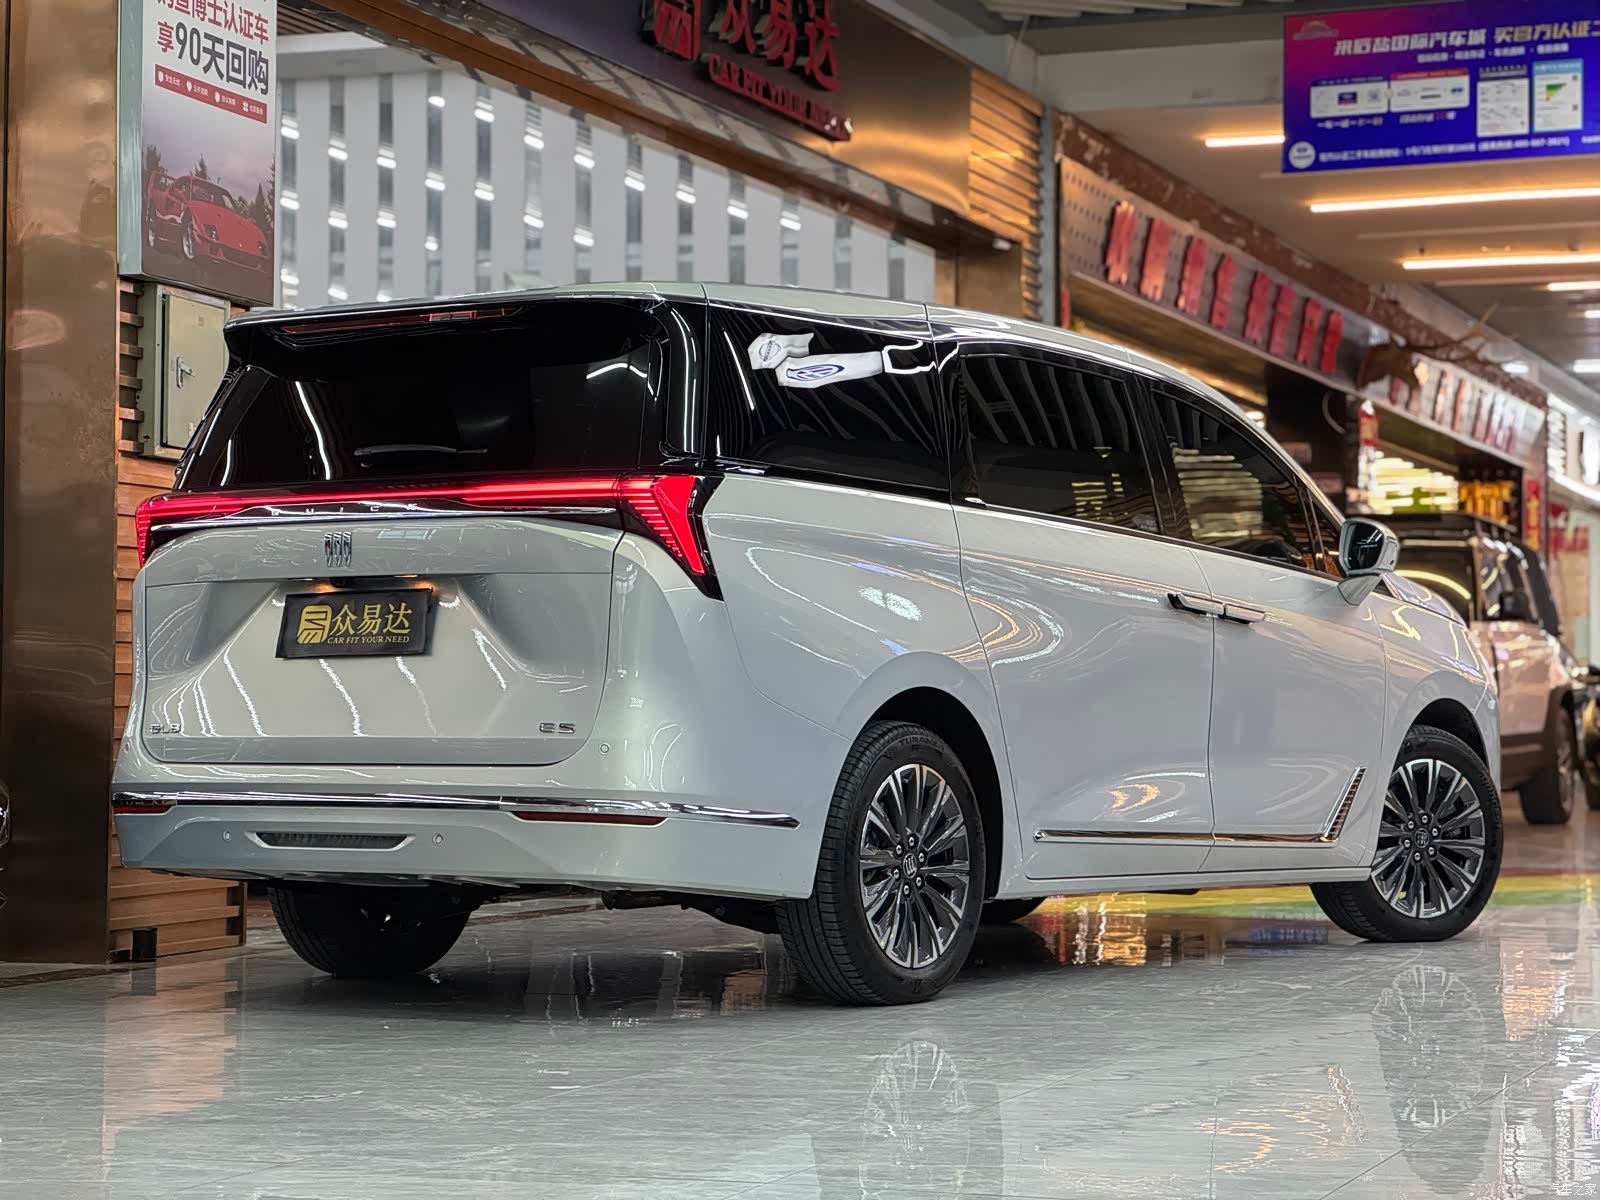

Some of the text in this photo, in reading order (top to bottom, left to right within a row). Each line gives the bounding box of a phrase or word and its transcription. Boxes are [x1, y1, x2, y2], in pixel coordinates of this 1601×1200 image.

[157, 21, 269, 96] 享90天回购
[329, 603, 413, 637] 众易达
[327, 635, 411, 645] CAR FIT YOUR NEED
[539, 722, 576, 735] ES
[898, 736, 945, 753] TURANZA
